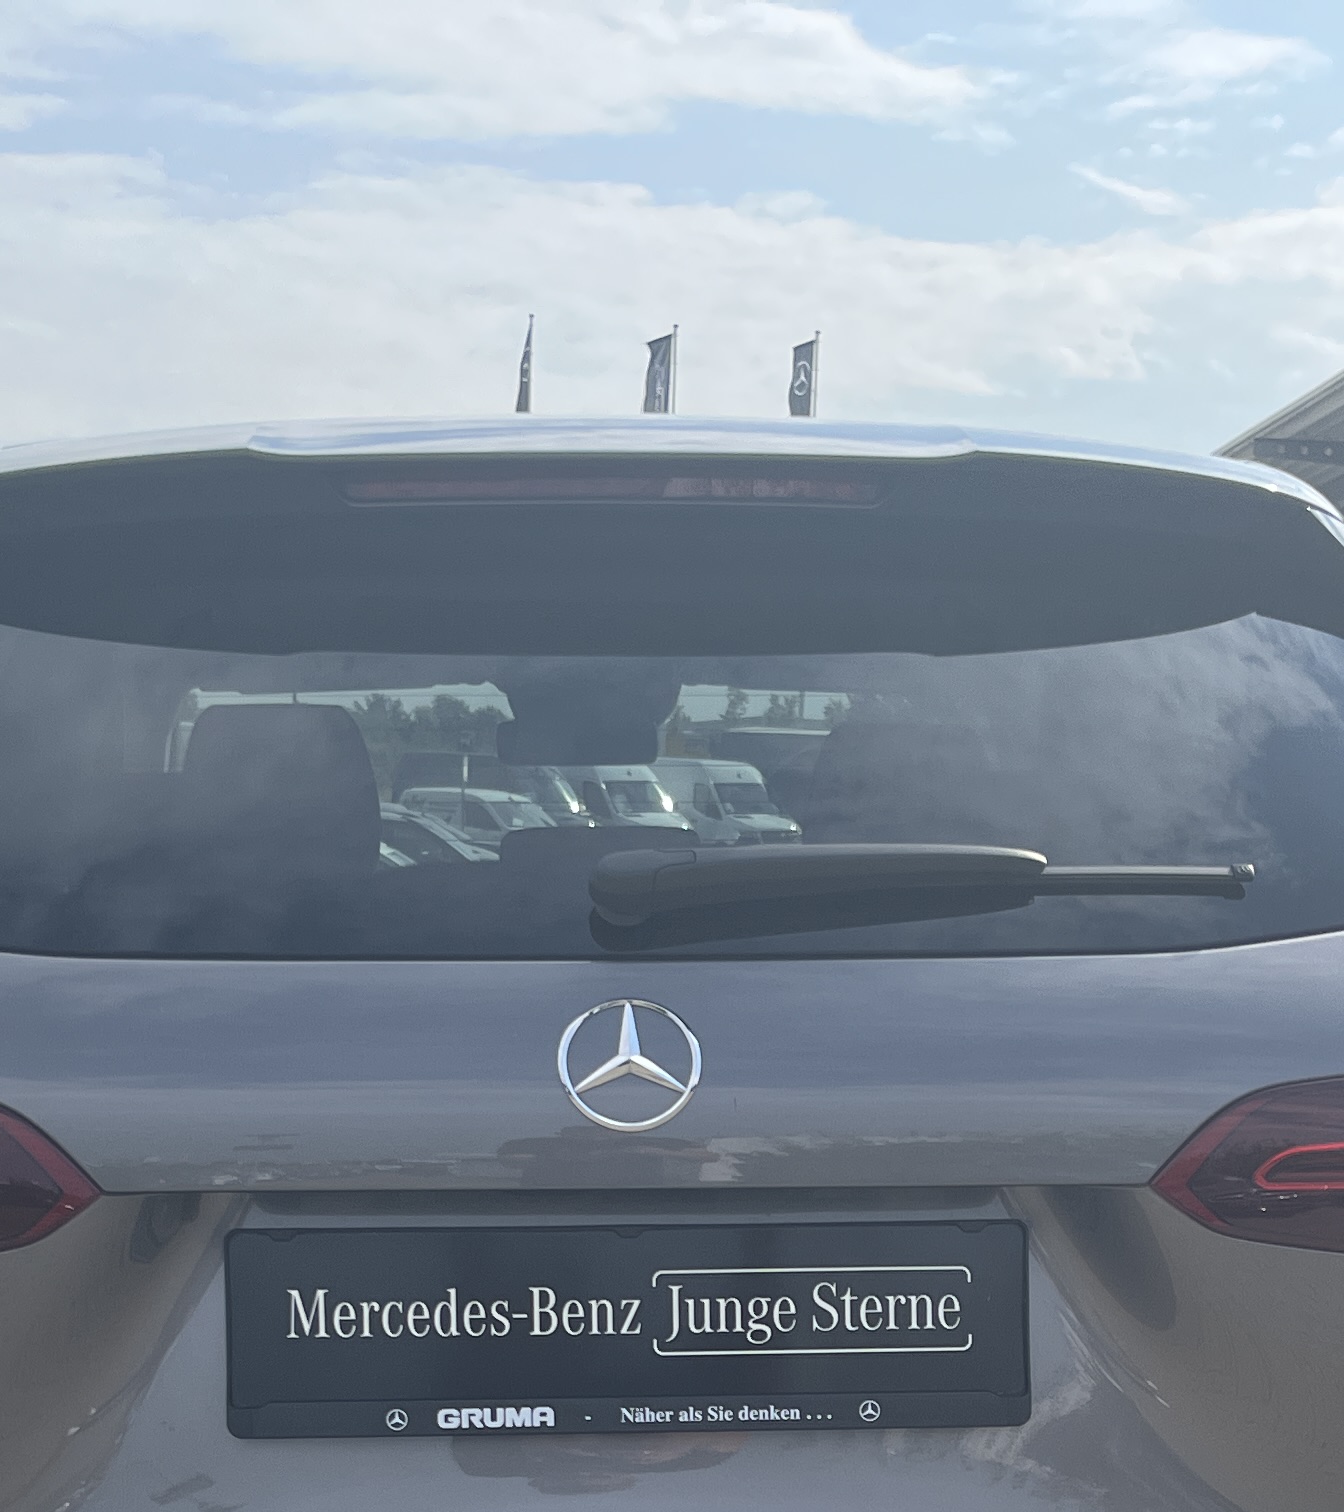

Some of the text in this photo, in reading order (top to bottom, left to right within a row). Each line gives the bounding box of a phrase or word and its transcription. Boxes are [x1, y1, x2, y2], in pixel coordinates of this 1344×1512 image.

[285, 1281, 962, 1345] Mercedes-Benz Junge Sterne
[436, 1405, 556, 1430] GRUMA
[620, 1406, 674, 1424] Näher
[678, 1406, 704, 1423] als
[707, 1405, 735, 1422] Sie
